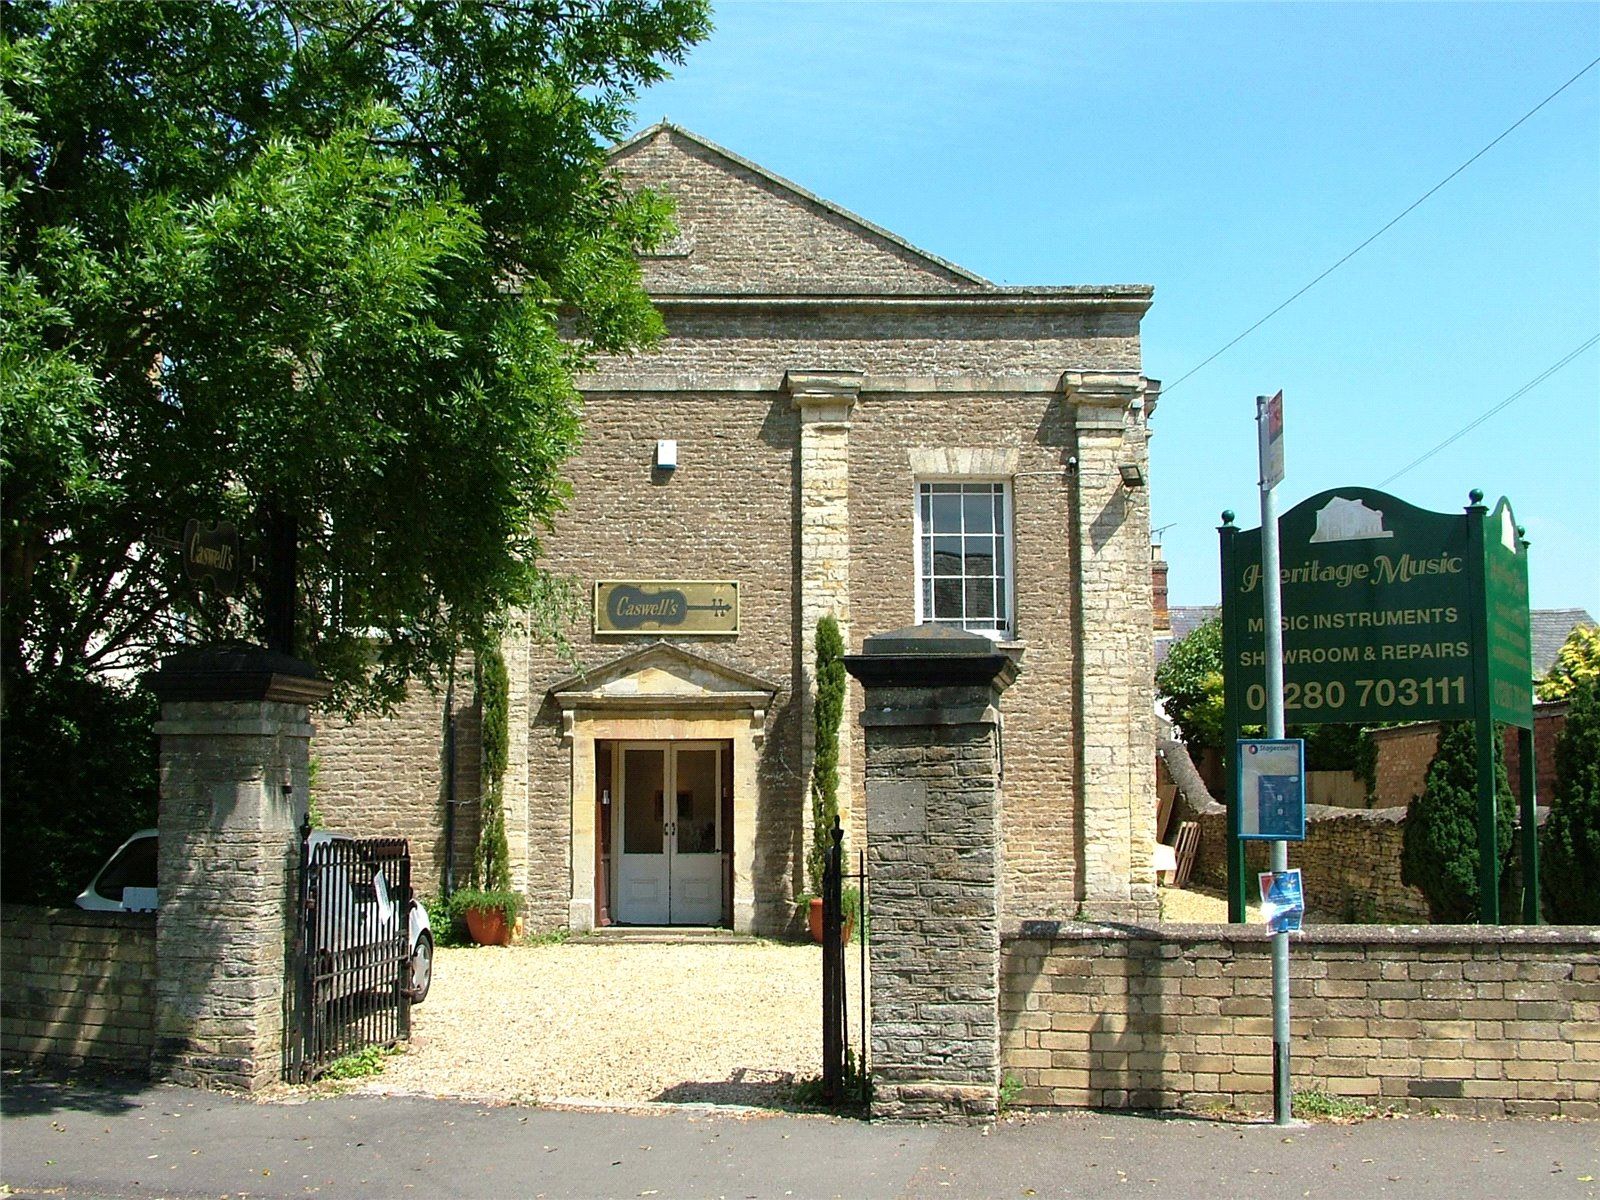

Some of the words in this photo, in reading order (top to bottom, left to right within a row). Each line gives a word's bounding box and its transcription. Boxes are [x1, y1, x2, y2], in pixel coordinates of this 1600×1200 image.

[190, 532, 234, 571] Caswell's
[1370, 552, 1462, 585] Music
[616, 596, 679, 617] Caswell's
[1248, 614, 1309, 633] MSIC
[1313, 607, 1458, 630] INSTRUMENTS
[1240, 647, 1359, 667] SHWROOM
[1363, 646, 1376, 661] &
[1381, 641, 1469, 661] REPAIRS
[1246, 680, 1346, 711] 0280
[1355, 676, 1465, 707] 703111
